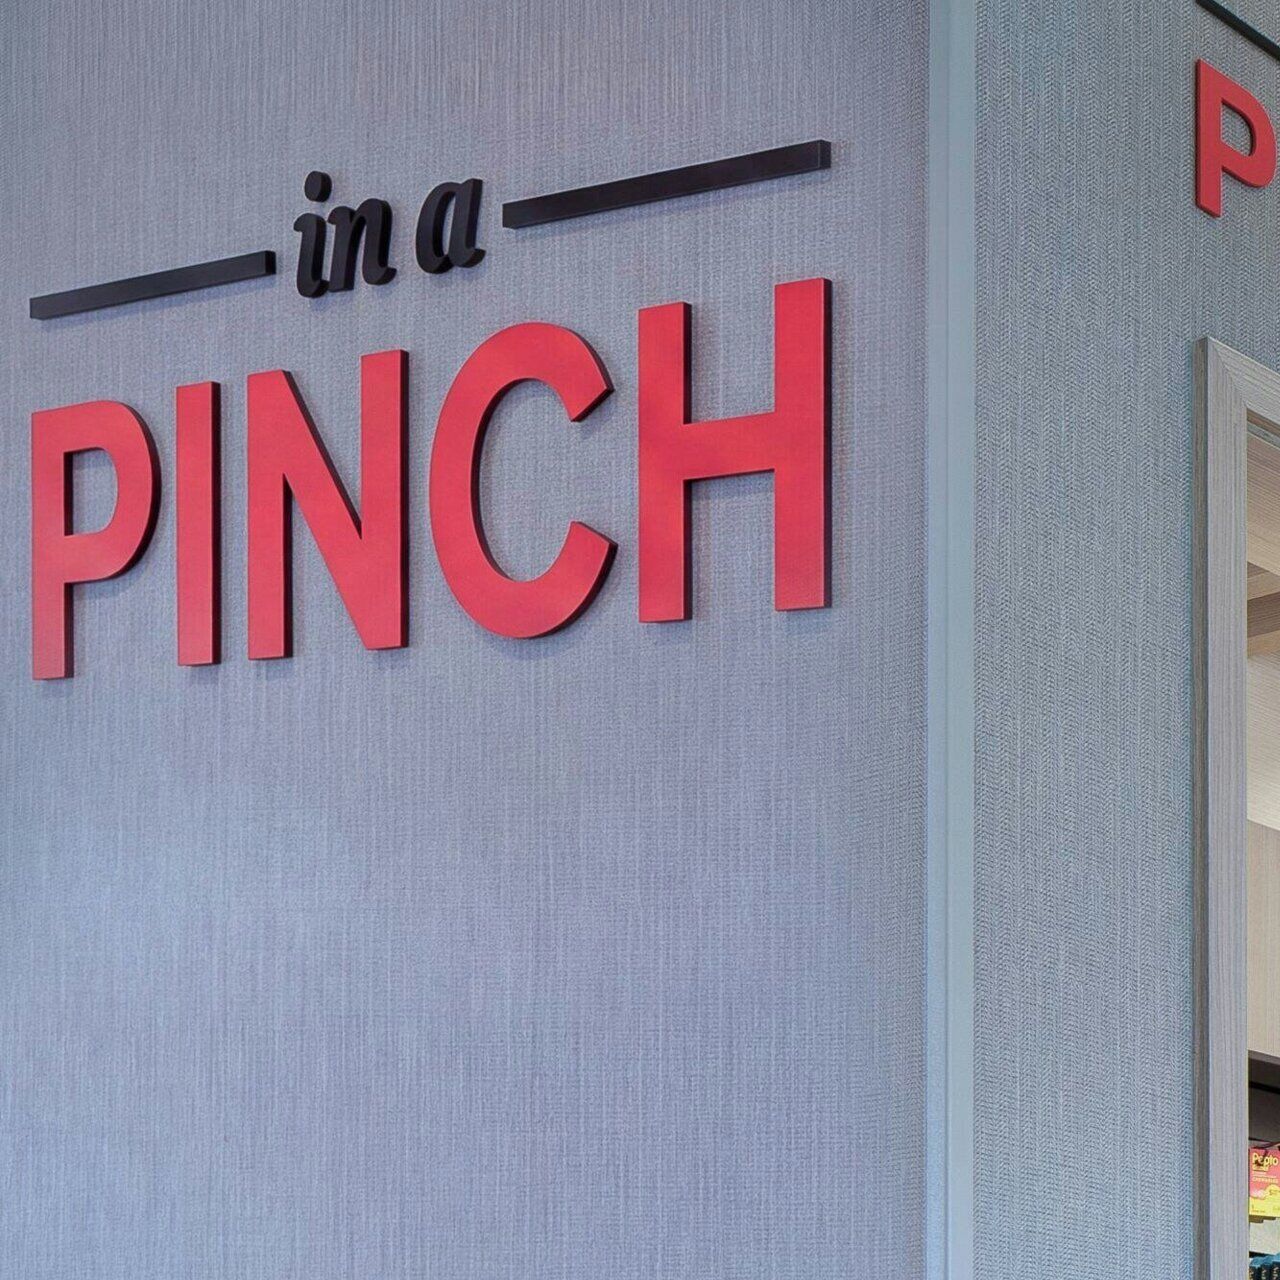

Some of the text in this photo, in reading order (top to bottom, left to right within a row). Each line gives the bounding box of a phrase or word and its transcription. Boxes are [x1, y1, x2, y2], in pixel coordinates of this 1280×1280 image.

[293, 170, 486, 298] in a
[31, 277, 832, 681] PINCH
[1252, 1152, 1279, 1166] Pepto
